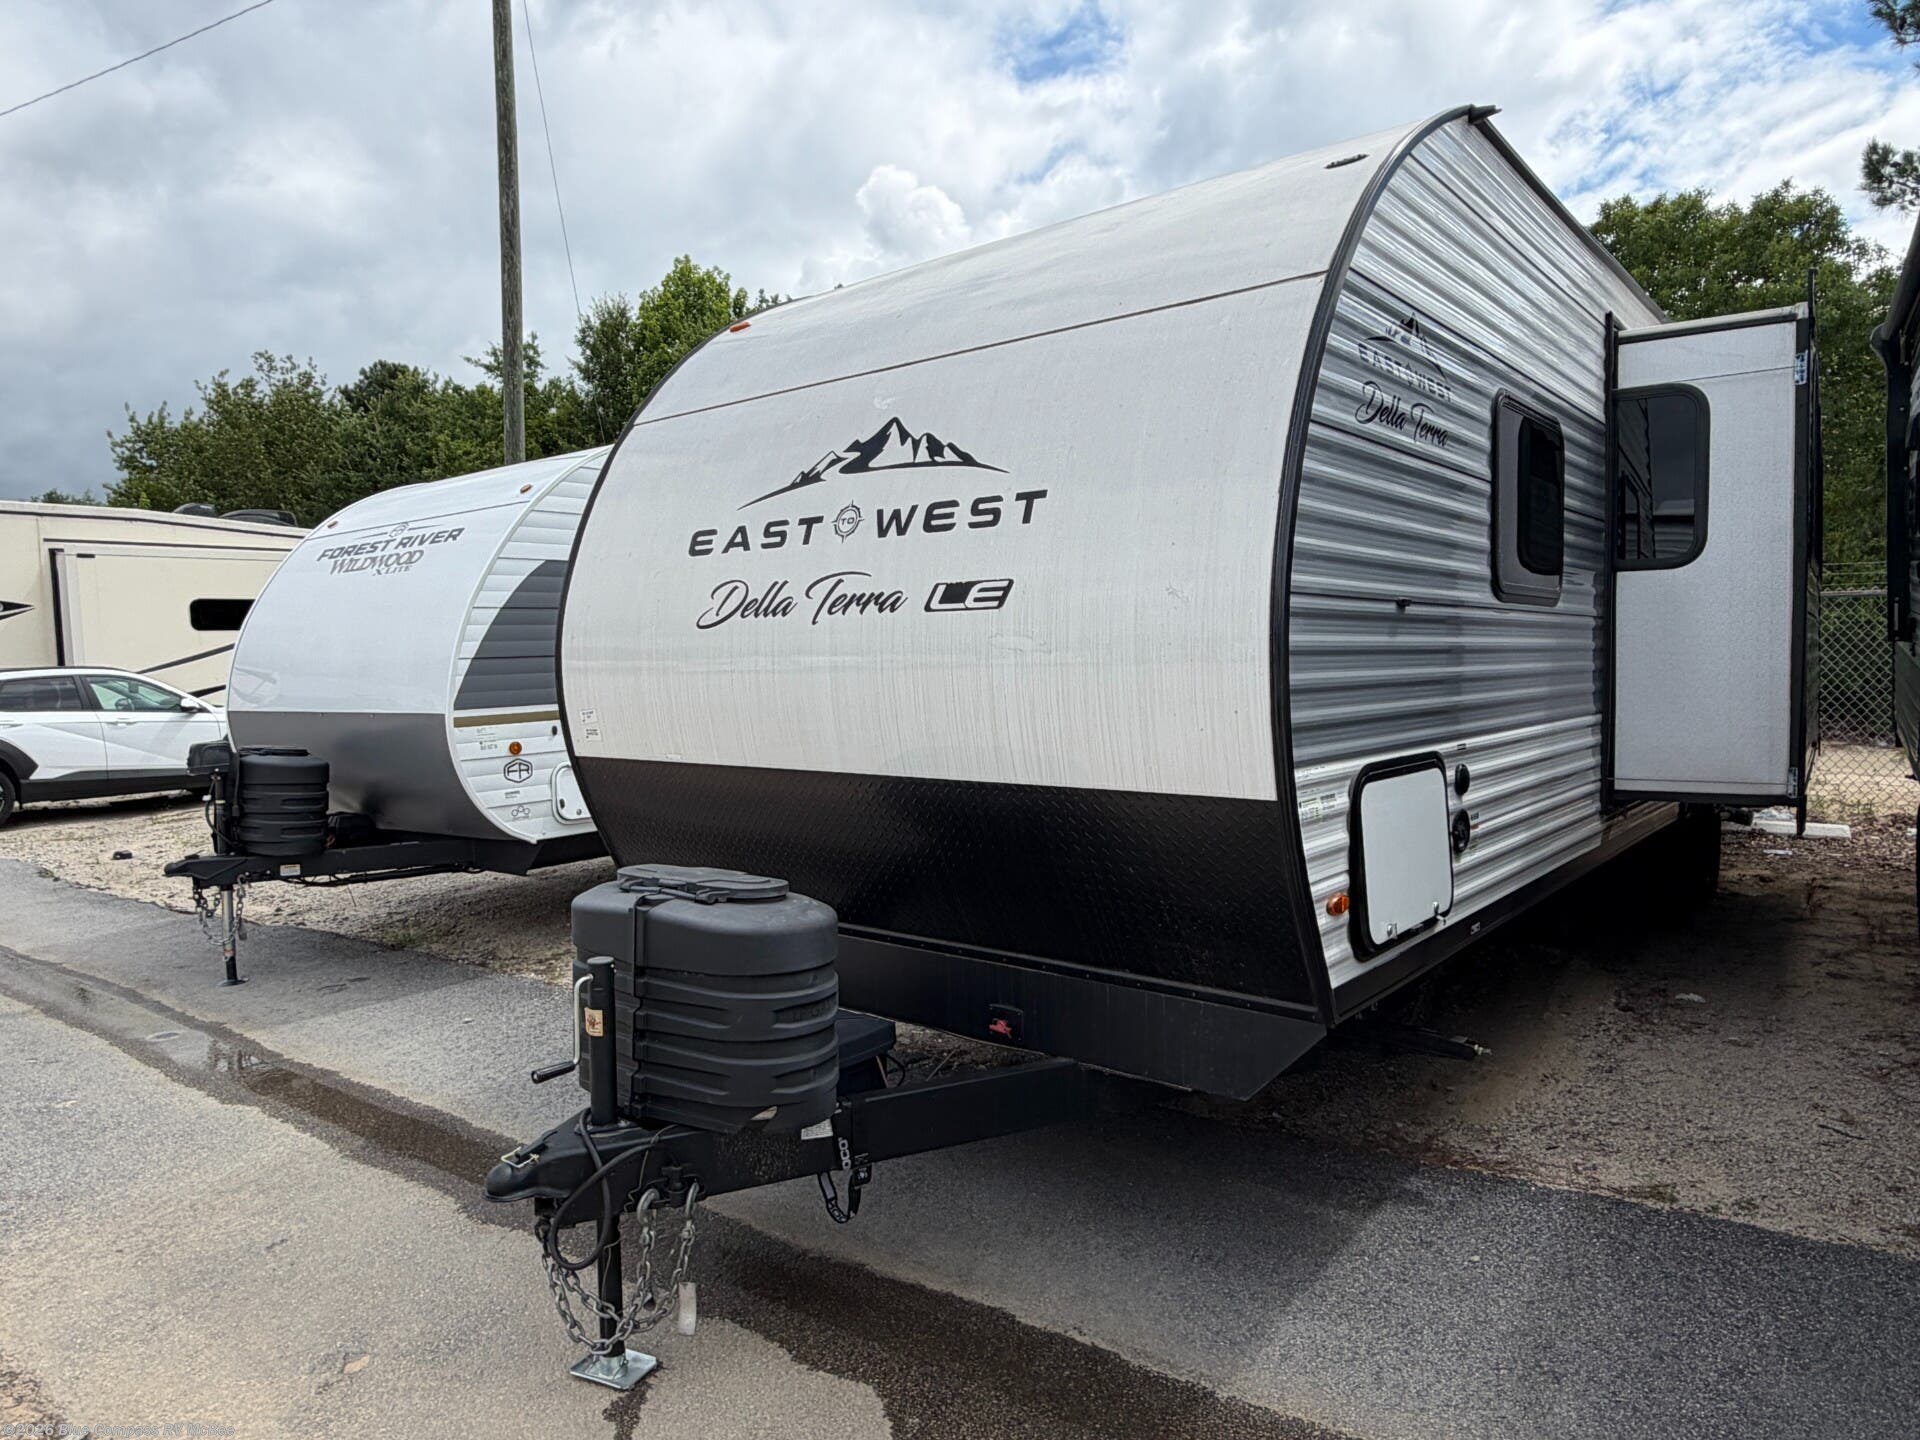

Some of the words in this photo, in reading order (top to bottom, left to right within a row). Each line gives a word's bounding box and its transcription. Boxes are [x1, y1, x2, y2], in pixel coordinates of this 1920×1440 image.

[1355, 381, 1407, 430] Della
[1411, 402, 1449, 446] Terra
[316, 538, 396, 562] FOREST
[394, 527, 466, 550] RIVER
[688, 515, 825, 557] EAST
[876, 489, 1049, 539] WEST
[330, 549, 424, 575] WILDWOOD
[696, 579, 798, 630] Della
[805, 570, 909, 626] Terra
[924, 578, 1015, 613] LE
